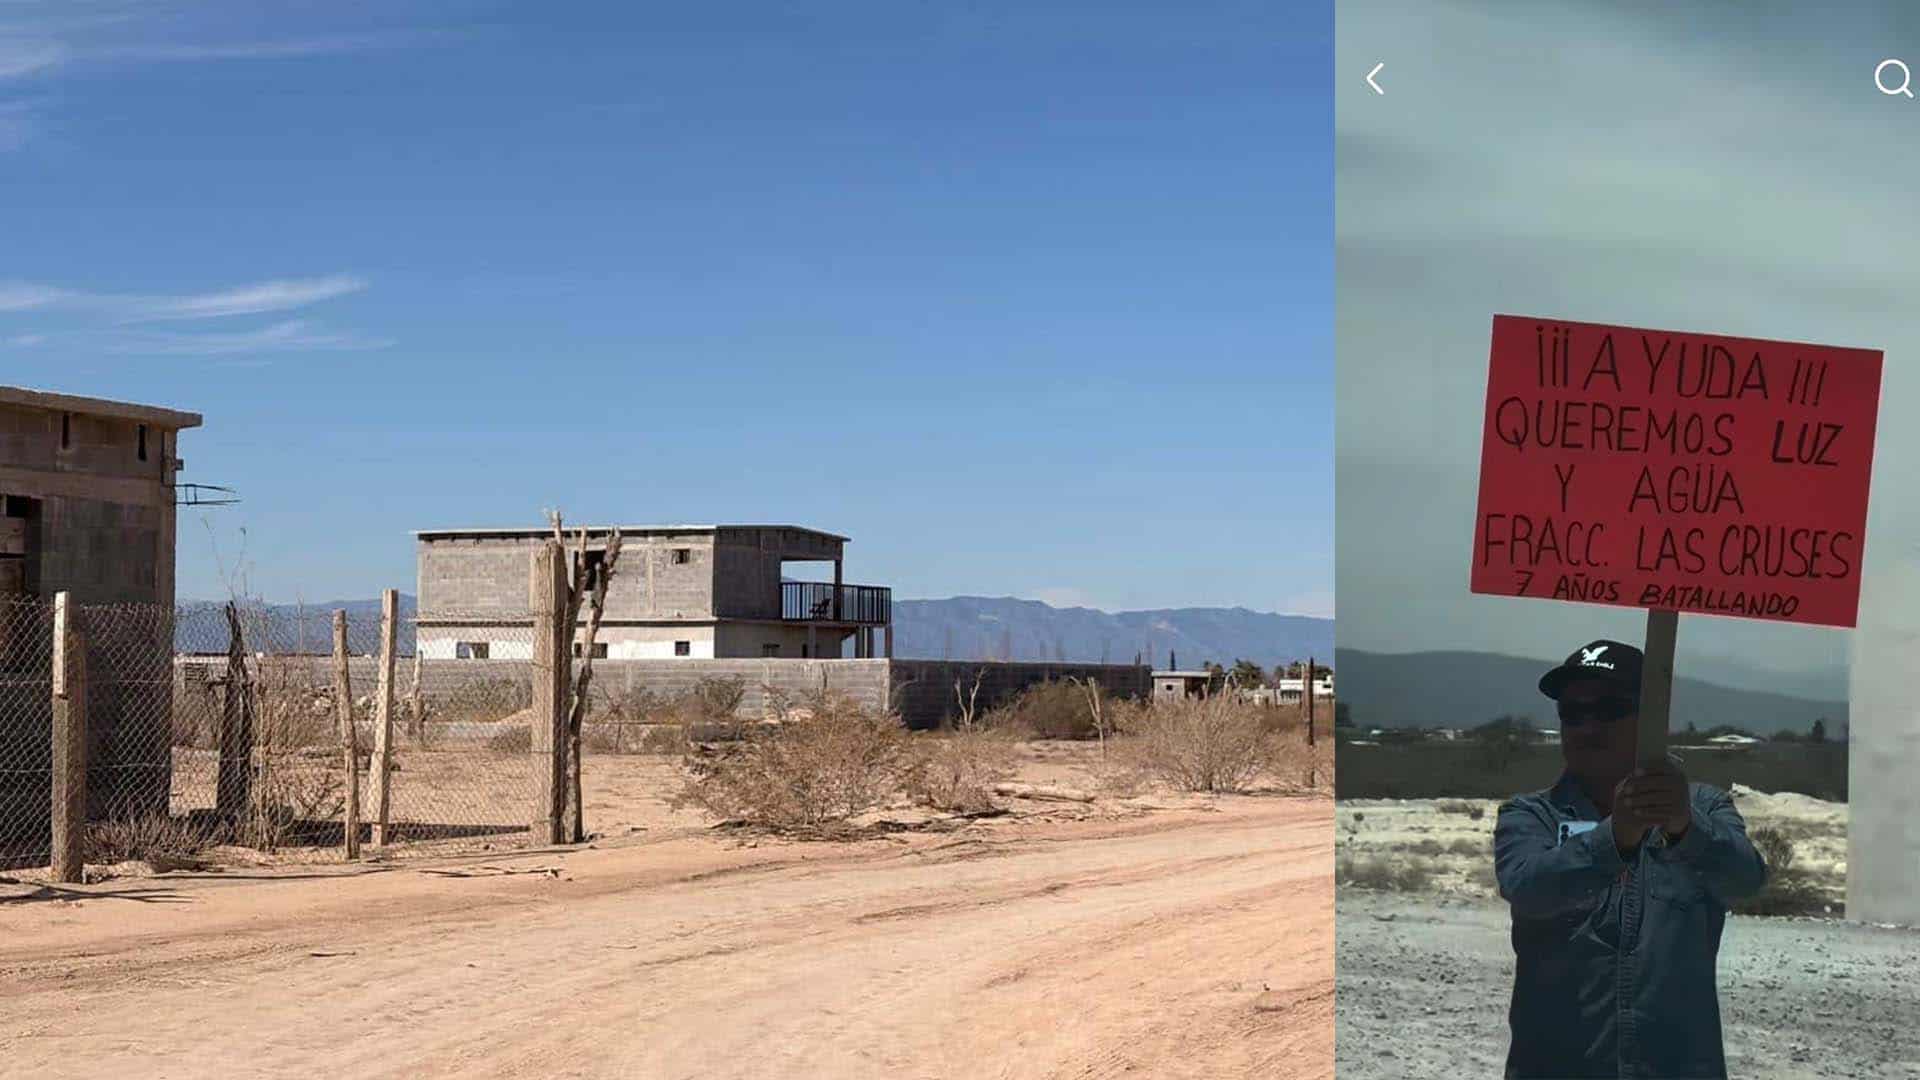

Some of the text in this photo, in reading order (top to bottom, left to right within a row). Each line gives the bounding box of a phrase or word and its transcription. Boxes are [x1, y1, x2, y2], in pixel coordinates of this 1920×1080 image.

[1495, 396, 1844, 467] QUEREMOS LUZ
[1554, 463, 1575, 512] Y
[1484, 514, 1853, 579] FRACC. LAS CRUSES
[1514, 570, 1800, 617] 7 AÑOS BATALLANDO
